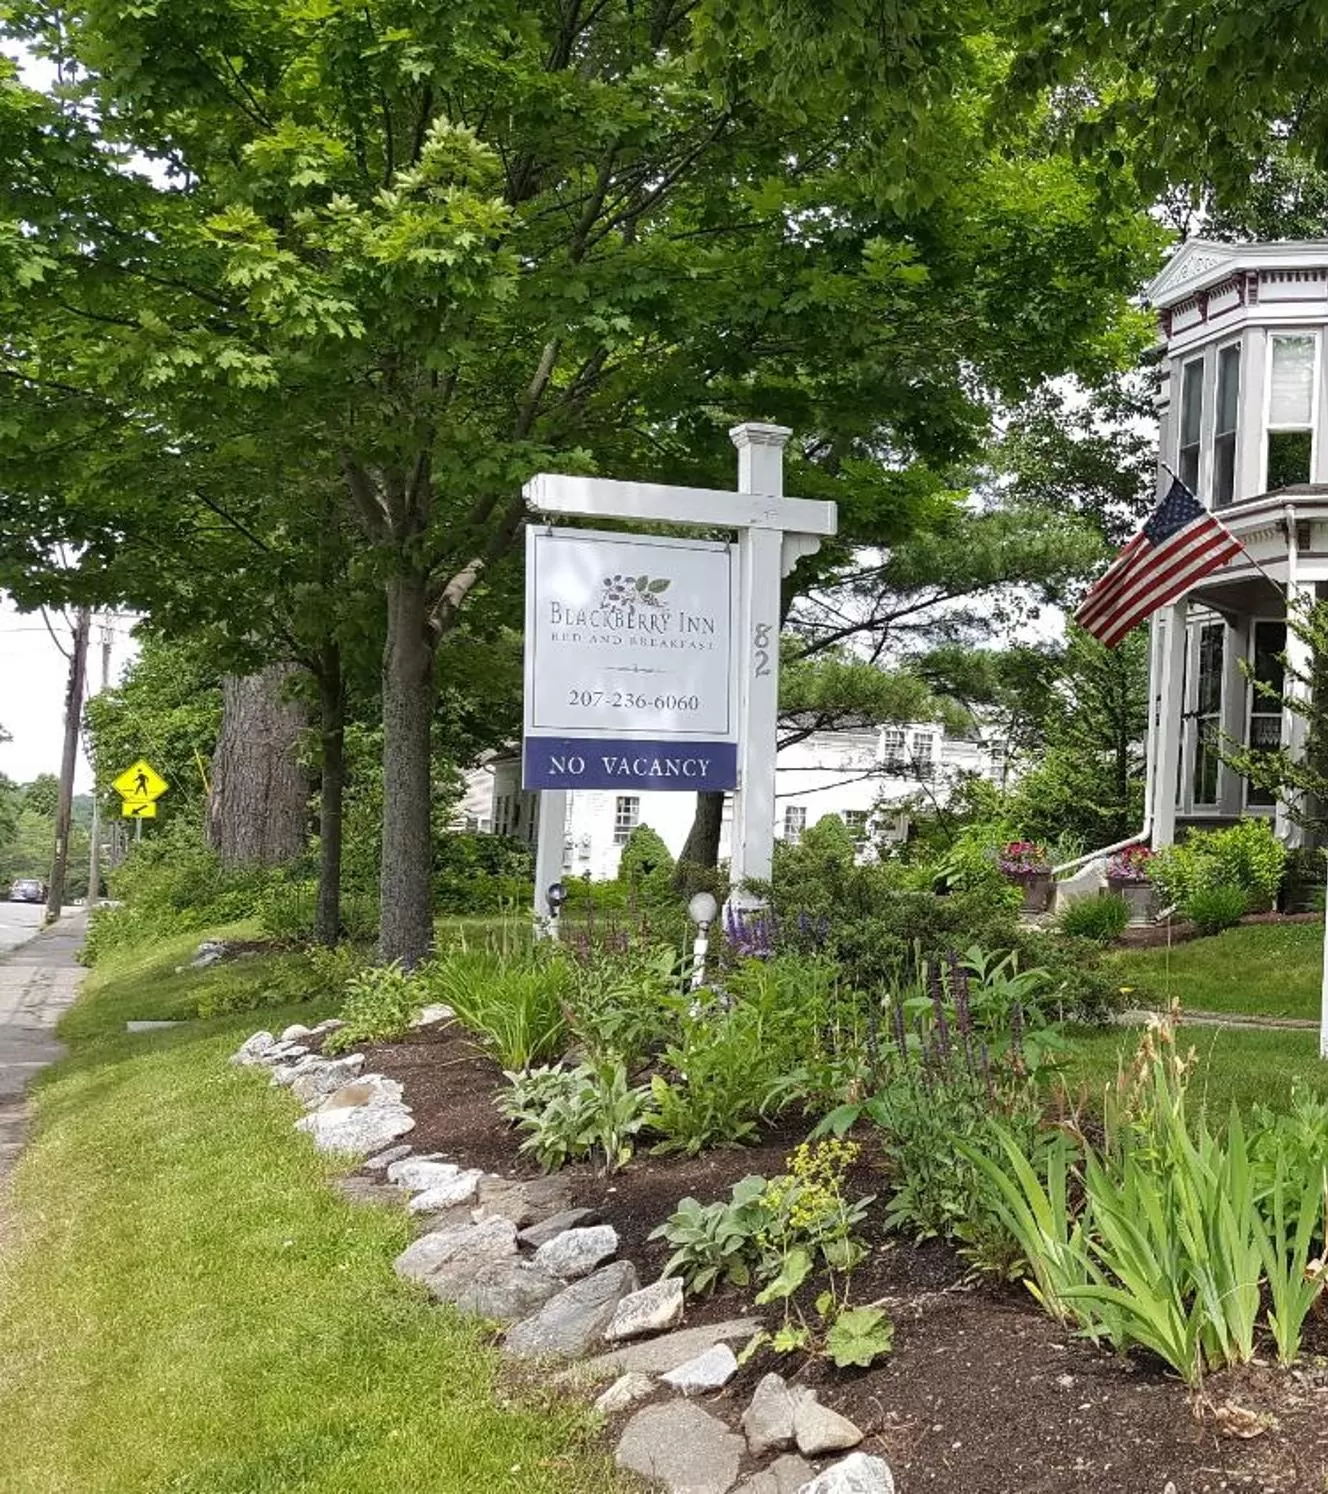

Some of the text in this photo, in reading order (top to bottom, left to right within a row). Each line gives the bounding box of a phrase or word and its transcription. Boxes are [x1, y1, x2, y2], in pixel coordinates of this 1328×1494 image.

[550, 601, 714, 634] BLACKBERRY INN
[551, 632, 714, 650] BED AND BREAKFAST
[569, 689, 699, 711] 207-236-6060
[549, 756, 711, 777] NO VACANCY
